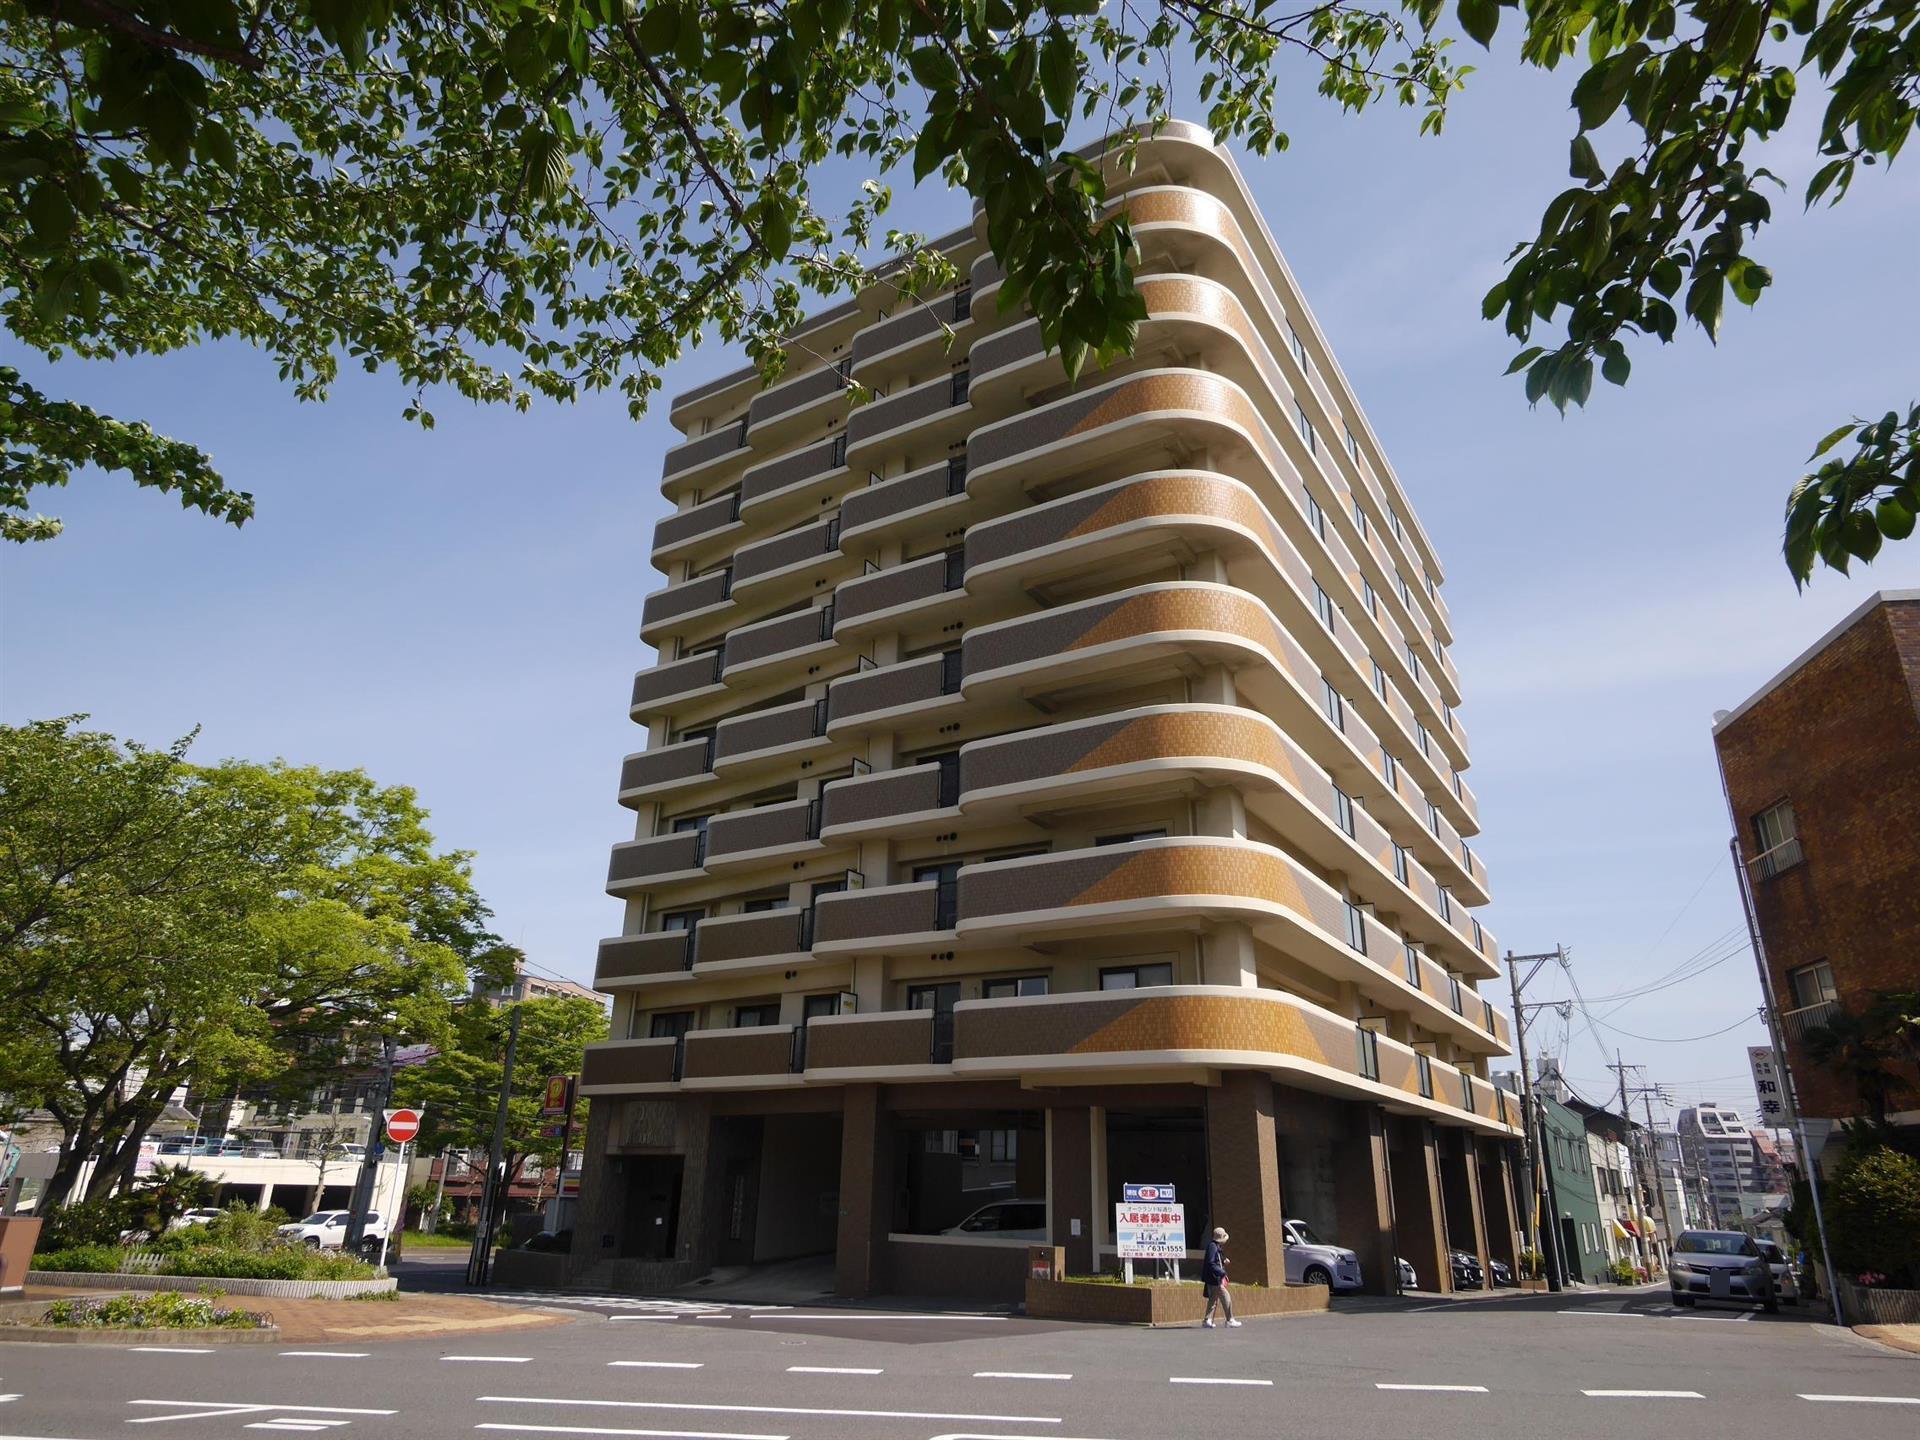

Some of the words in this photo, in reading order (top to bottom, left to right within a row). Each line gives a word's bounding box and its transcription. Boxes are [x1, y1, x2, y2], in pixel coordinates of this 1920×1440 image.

[1758, 1080, 1780, 1114] 和幸
[1141, 1189, 1156, 1198] 空室
[1120, 1213, 1181, 1224] 入居者募集中
